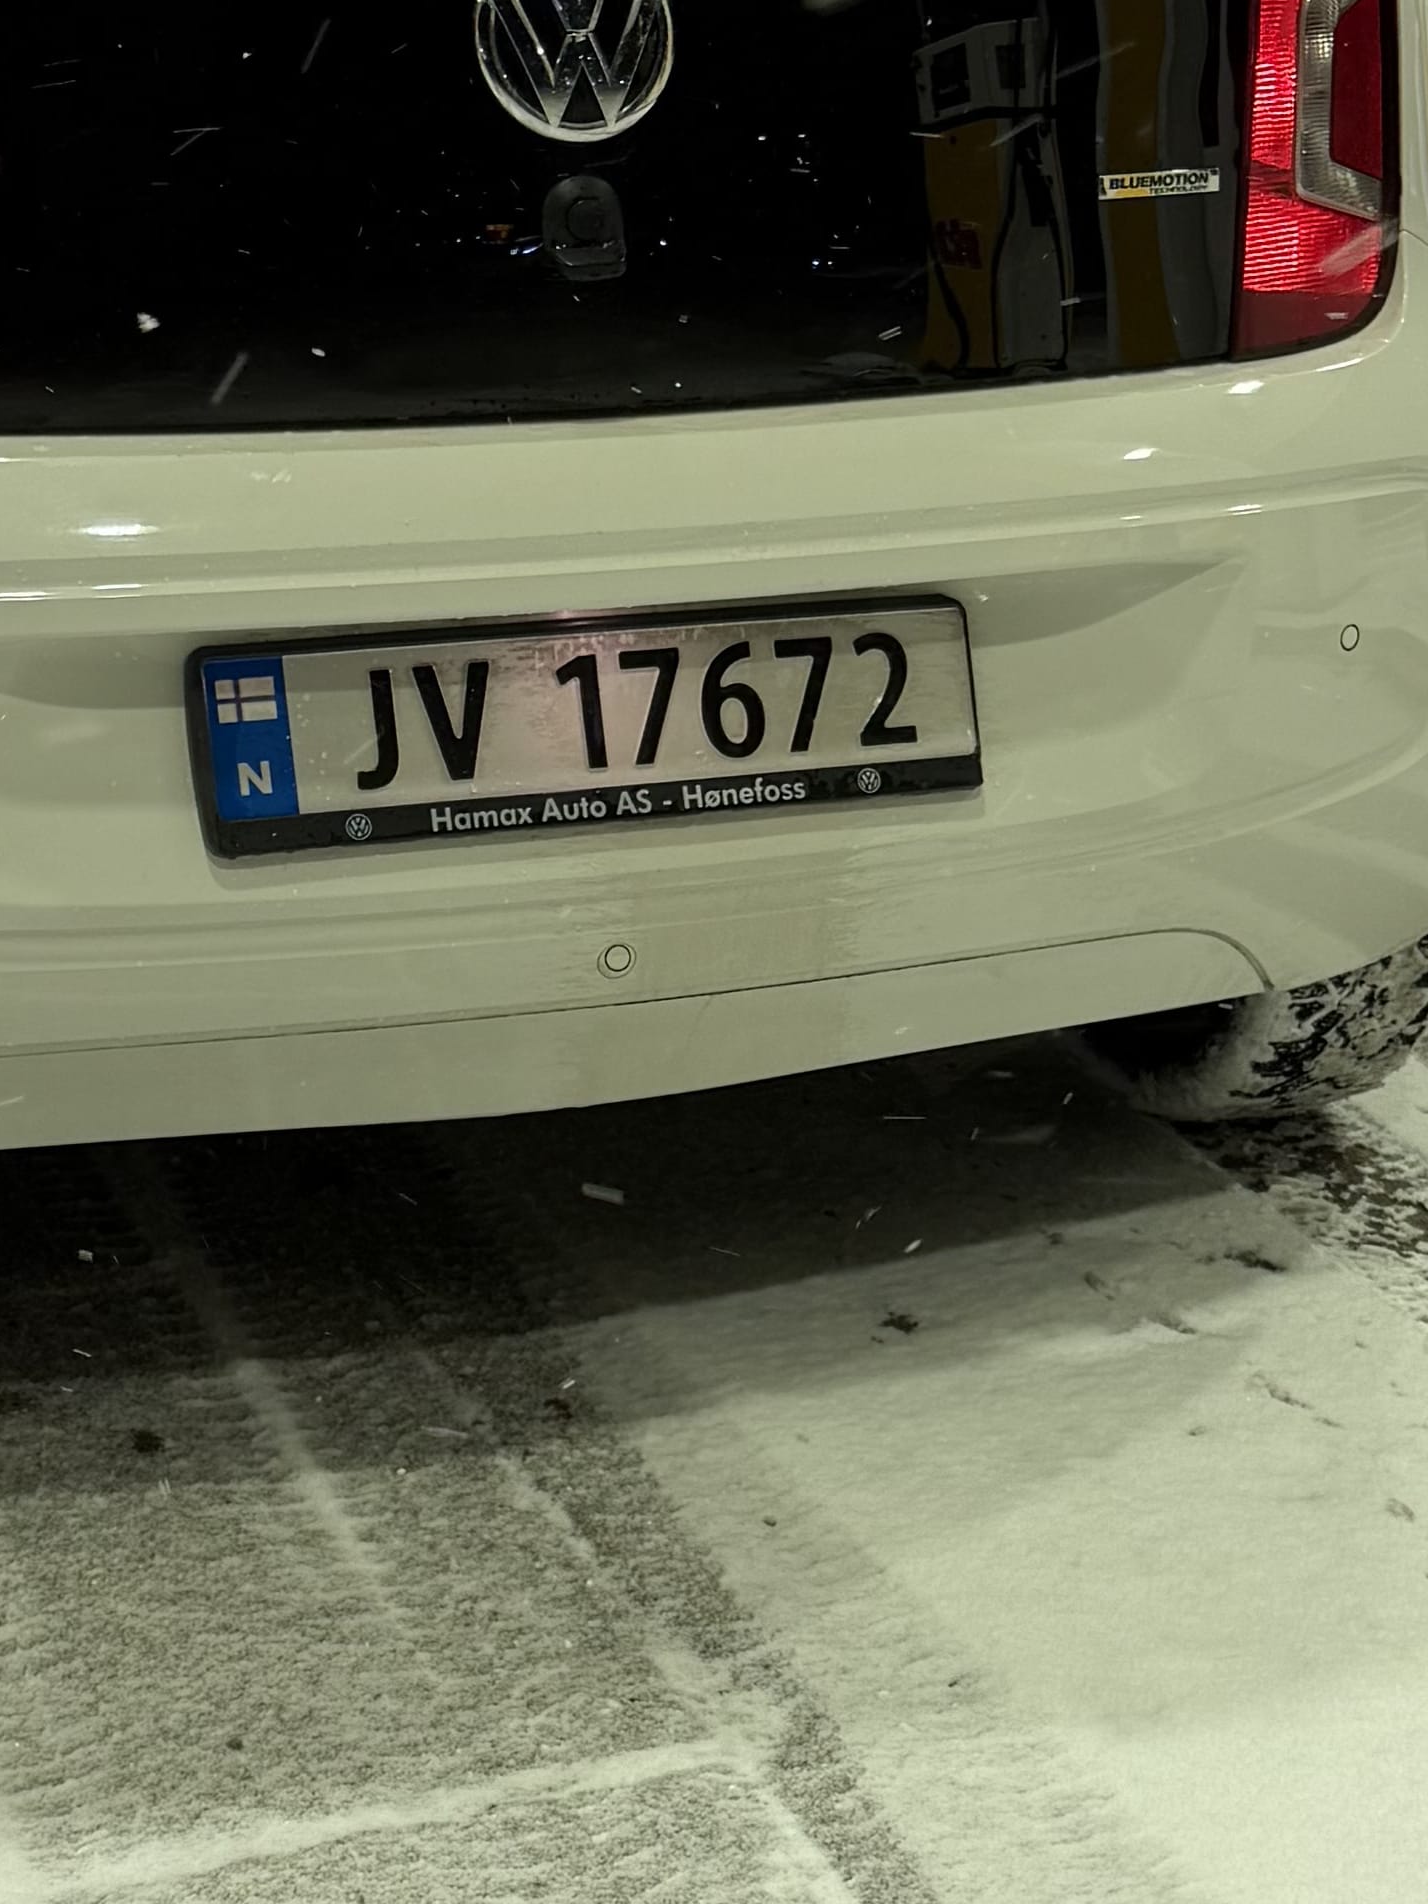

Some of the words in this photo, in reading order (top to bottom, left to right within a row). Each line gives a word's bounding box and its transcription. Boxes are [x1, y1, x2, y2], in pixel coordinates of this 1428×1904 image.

[1109, 172, 1209, 190] BLUEMOTION
[356, 660, 490, 790] JV
[556, 632, 918, 772] 17672
[237, 760, 273, 797] N
[430, 807, 533, 833] Hamax
[542, 796, 607, 823] Auto
[616, 789, 650, 816] AS
[682, 780, 806, 810] Hønefoss
